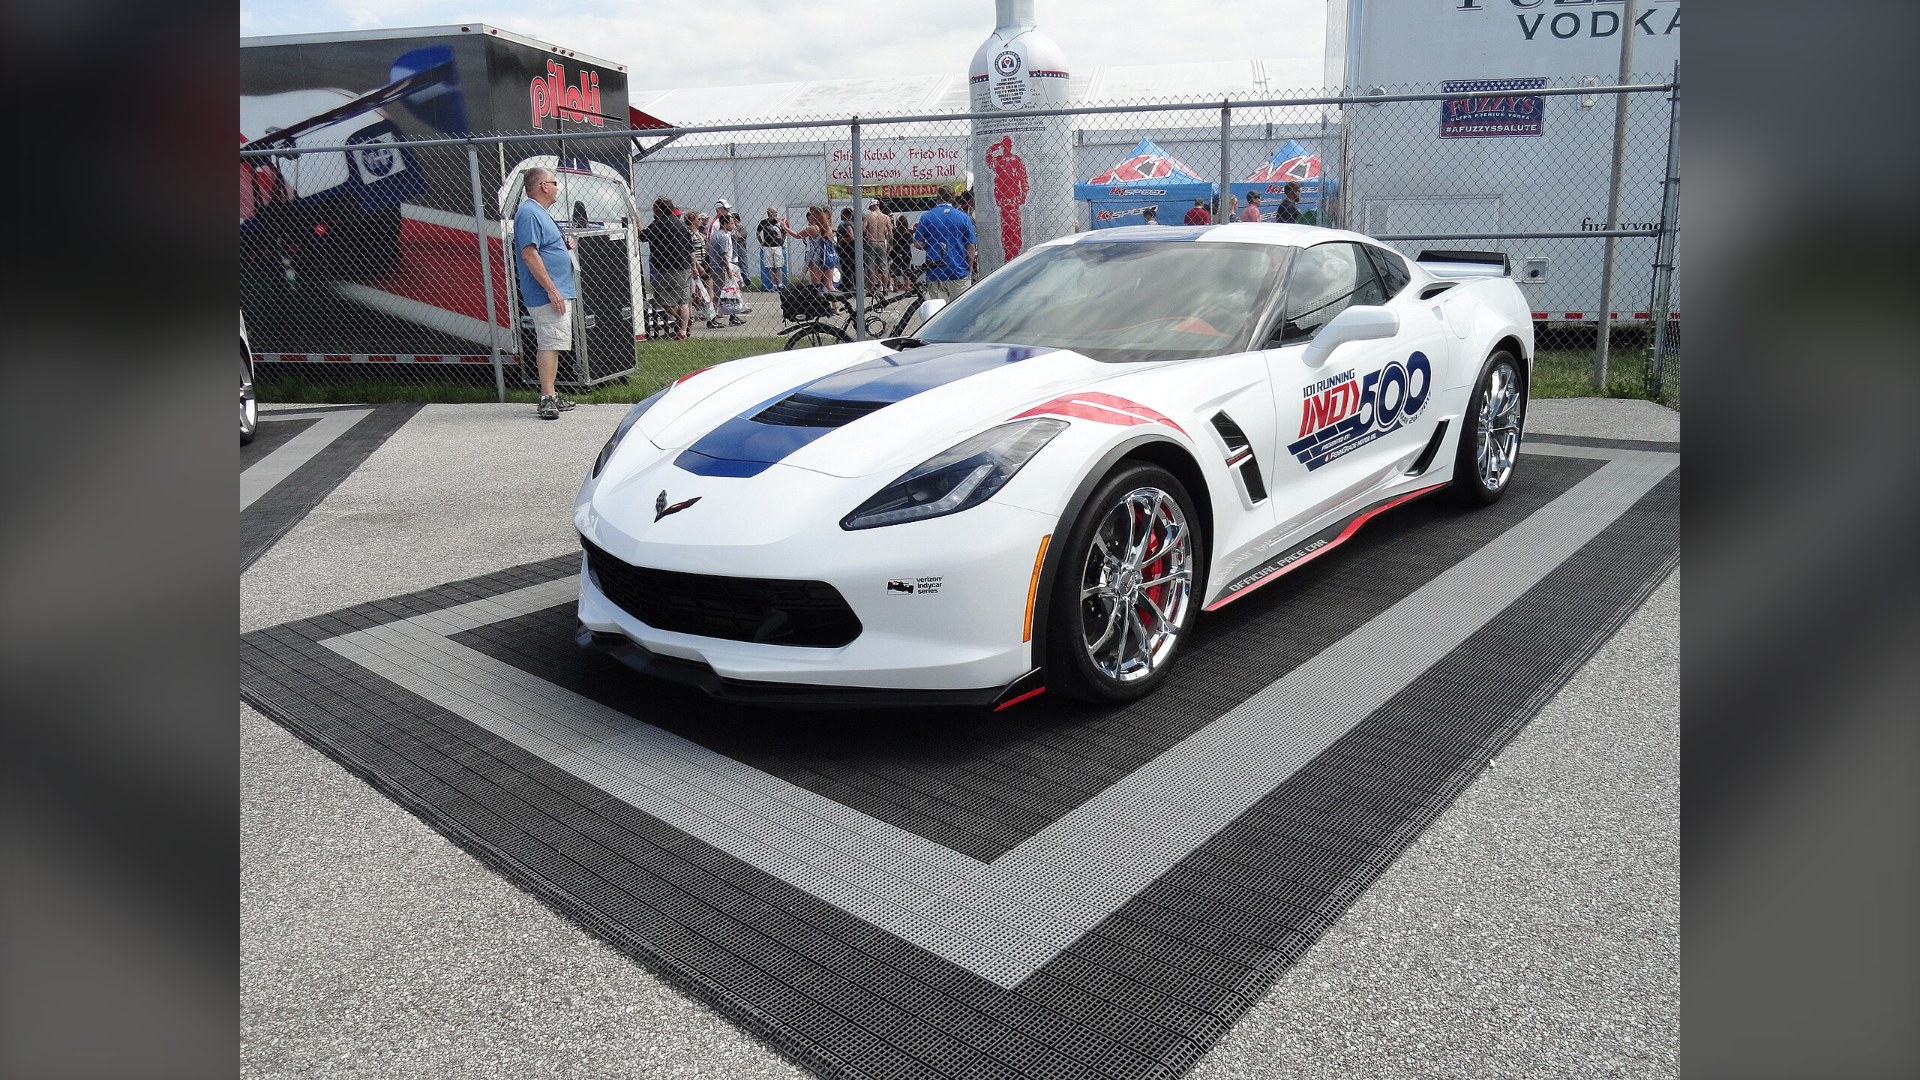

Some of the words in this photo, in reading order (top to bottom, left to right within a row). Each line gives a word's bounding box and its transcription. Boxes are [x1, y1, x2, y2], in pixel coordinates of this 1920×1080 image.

[530, 59, 604, 129] piloti
[1445, 124, 1537, 133] #AFUZZYSSALUTE
[864, 148, 896, 161] Kebab
[908, 147, 935, 160] Fried
[938, 147, 959, 159] Rice
[860, 168, 901, 181] Rangoon
[912, 165, 933, 180] Egg
[937, 164, 956, 177] Roll
[874, 184, 939, 198] LEMONAD
[1303, 385, 1316, 399] 101
[1316, 368, 1356, 392] RUNNING
[1298, 379, 1360, 439] INDY
[1359, 351, 1431, 436] 500
[1229, 565, 1279, 592] OFFICIAL
[1277, 549, 1306, 568] PACE
[1304, 539, 1329, 553] CAR
[917, 582, 943, 590] indycar
